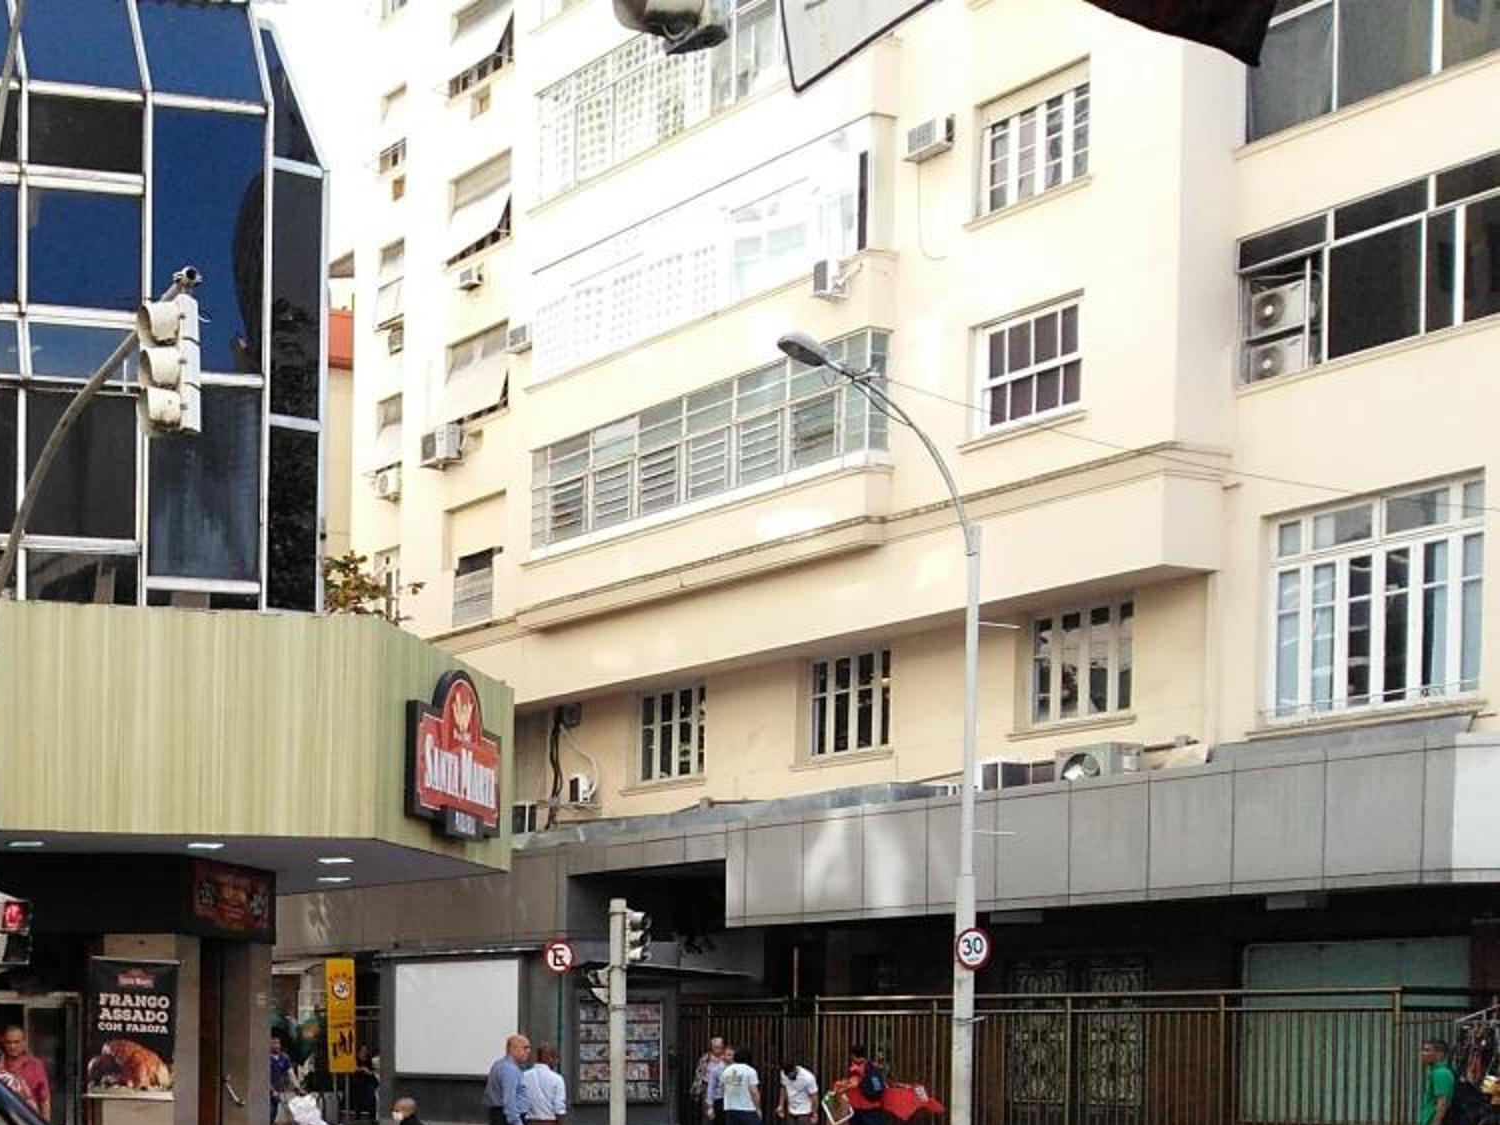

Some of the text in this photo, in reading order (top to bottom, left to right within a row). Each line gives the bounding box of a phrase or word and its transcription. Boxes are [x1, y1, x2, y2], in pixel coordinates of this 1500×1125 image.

[962, 936, 984, 957] 30
[99, 992, 170, 1009] FRANGO
[99, 1007, 169, 1024] ASSADO
[98, 1021, 168, 1034] COM FAROFA
